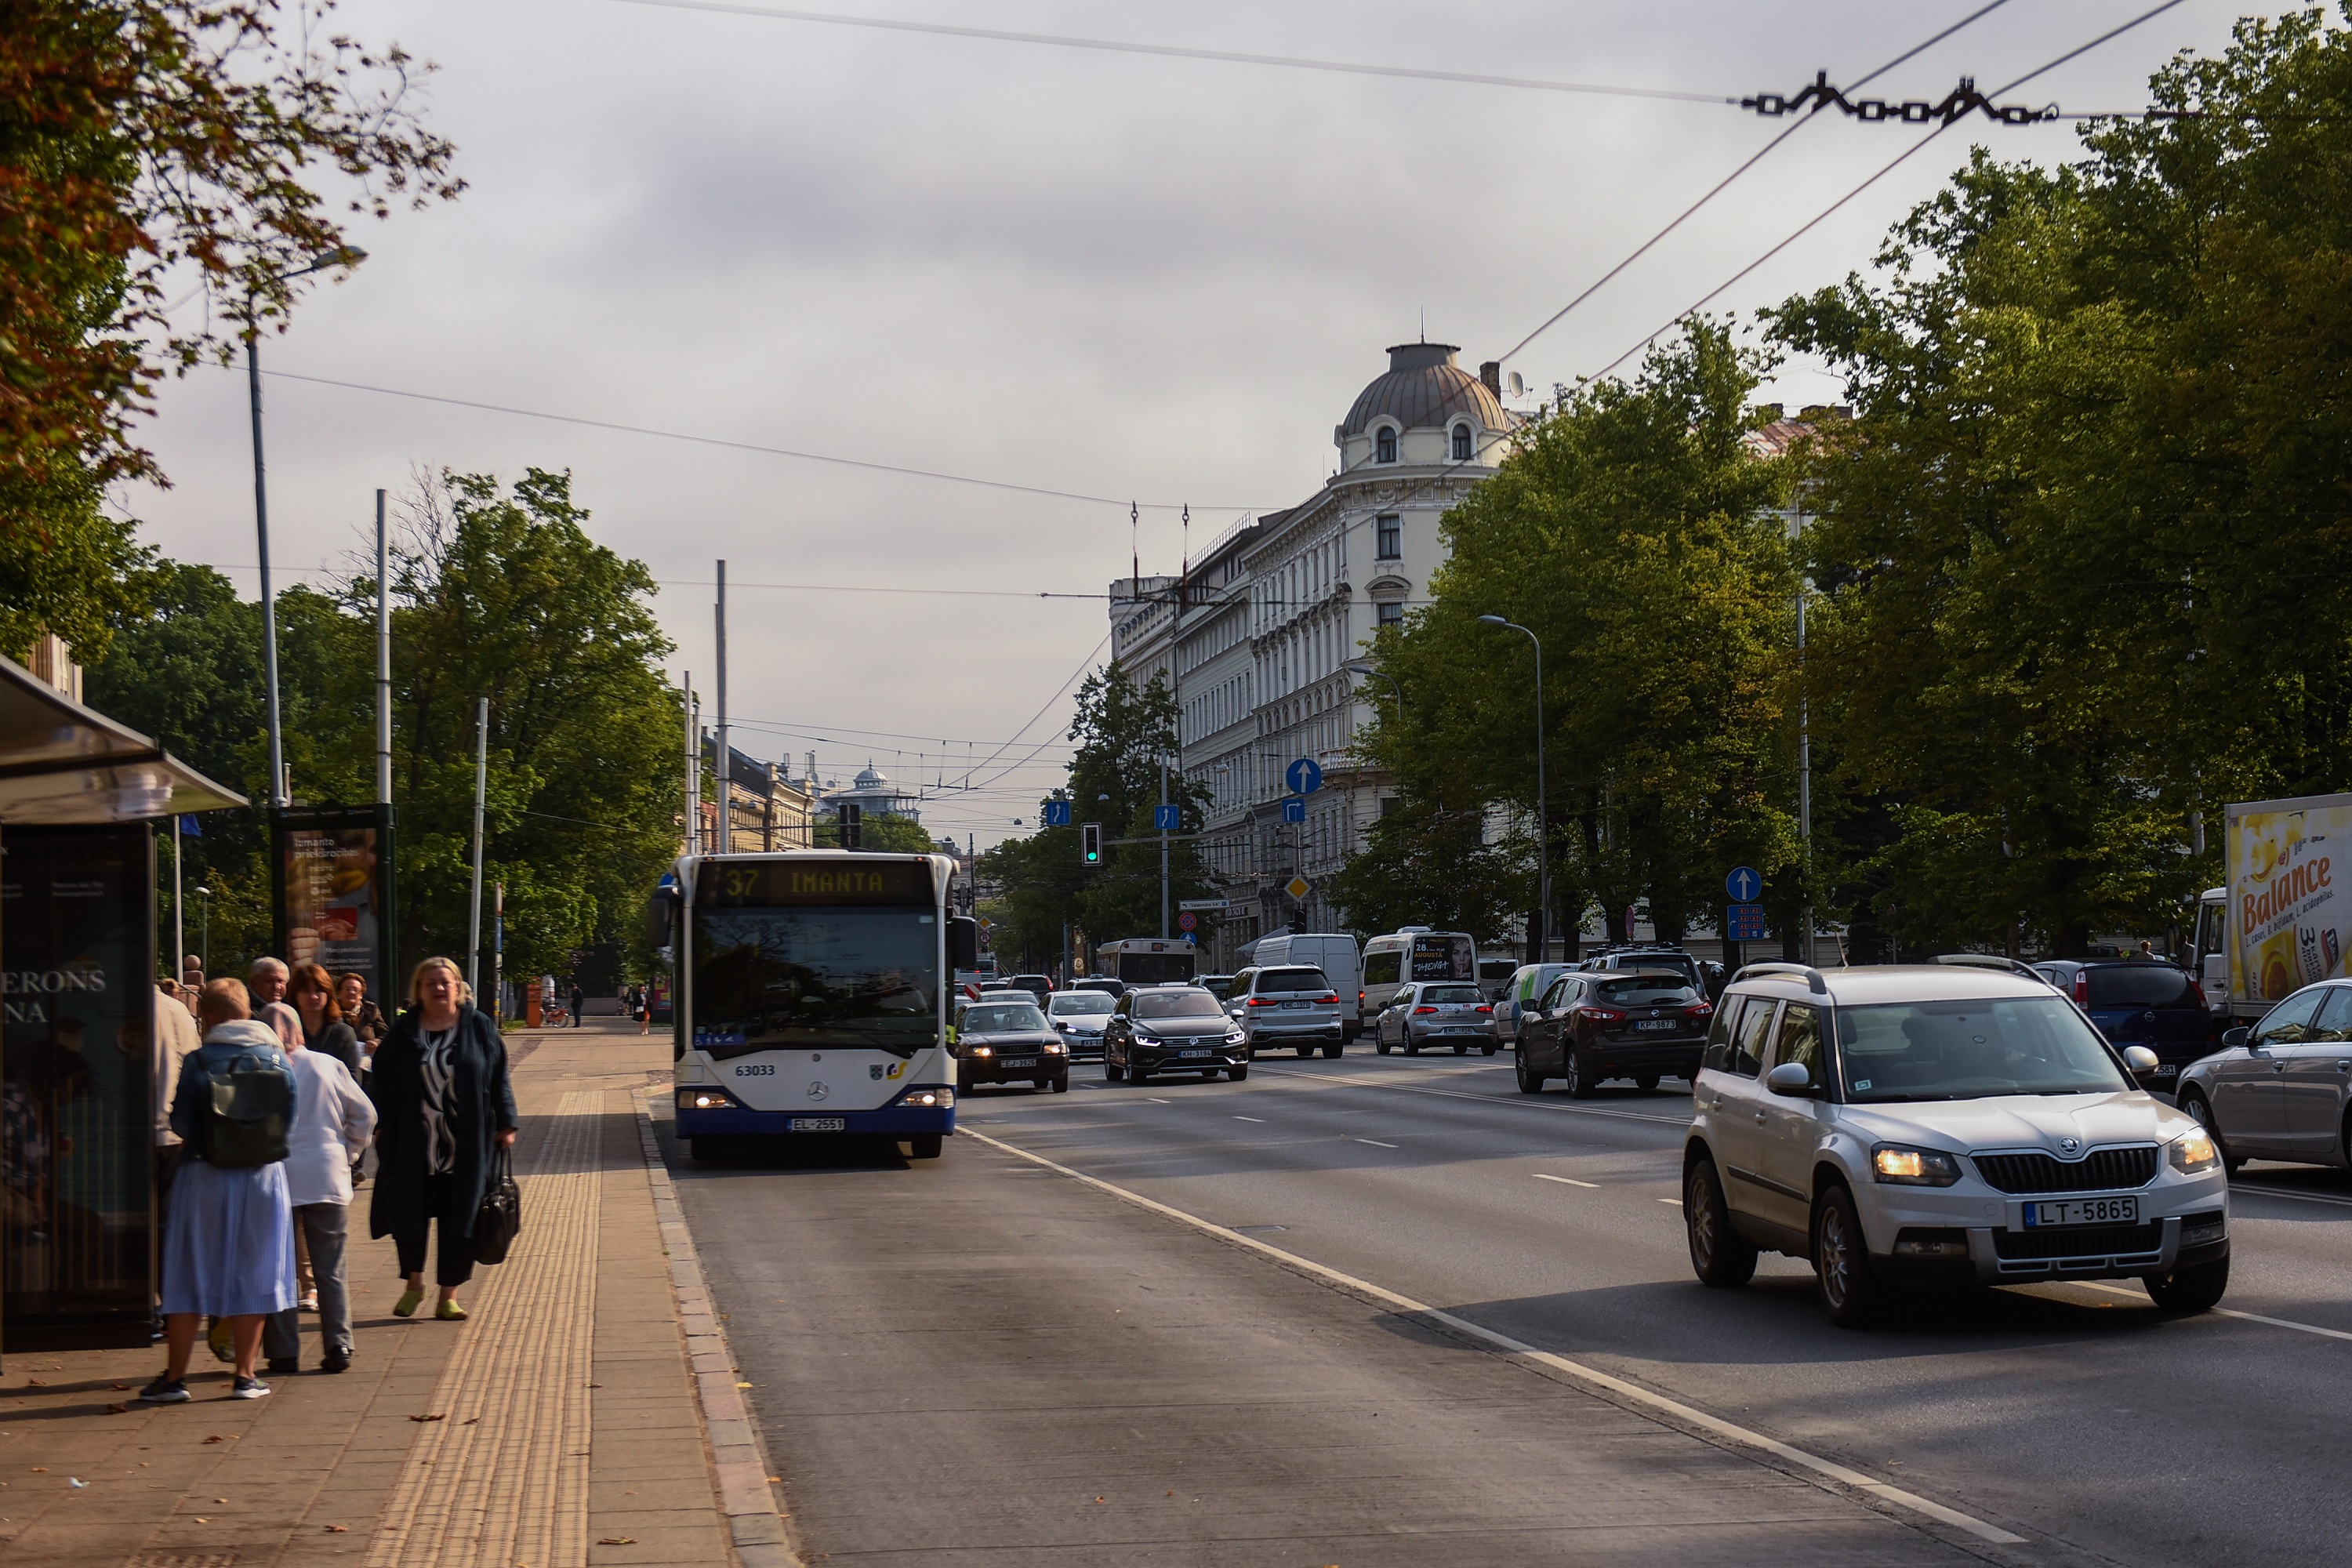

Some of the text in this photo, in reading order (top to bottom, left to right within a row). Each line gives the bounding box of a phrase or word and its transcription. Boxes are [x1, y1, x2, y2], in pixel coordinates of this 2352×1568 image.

[295, 838, 335, 848] Izmanto
[727, 869, 760, 897] 37
[791, 872, 884, 892] IMANTA
[2243, 857, 2331, 935] Balance
[1640, 1019, 1675, 1029] KP-9873
[735, 1065, 775, 1076] 63033
[2155, 1065, 2175, 1074] 581
[793, 1119, 843, 1130] EL-2551
[2040, 1200, 2132, 1224] LT-5865
